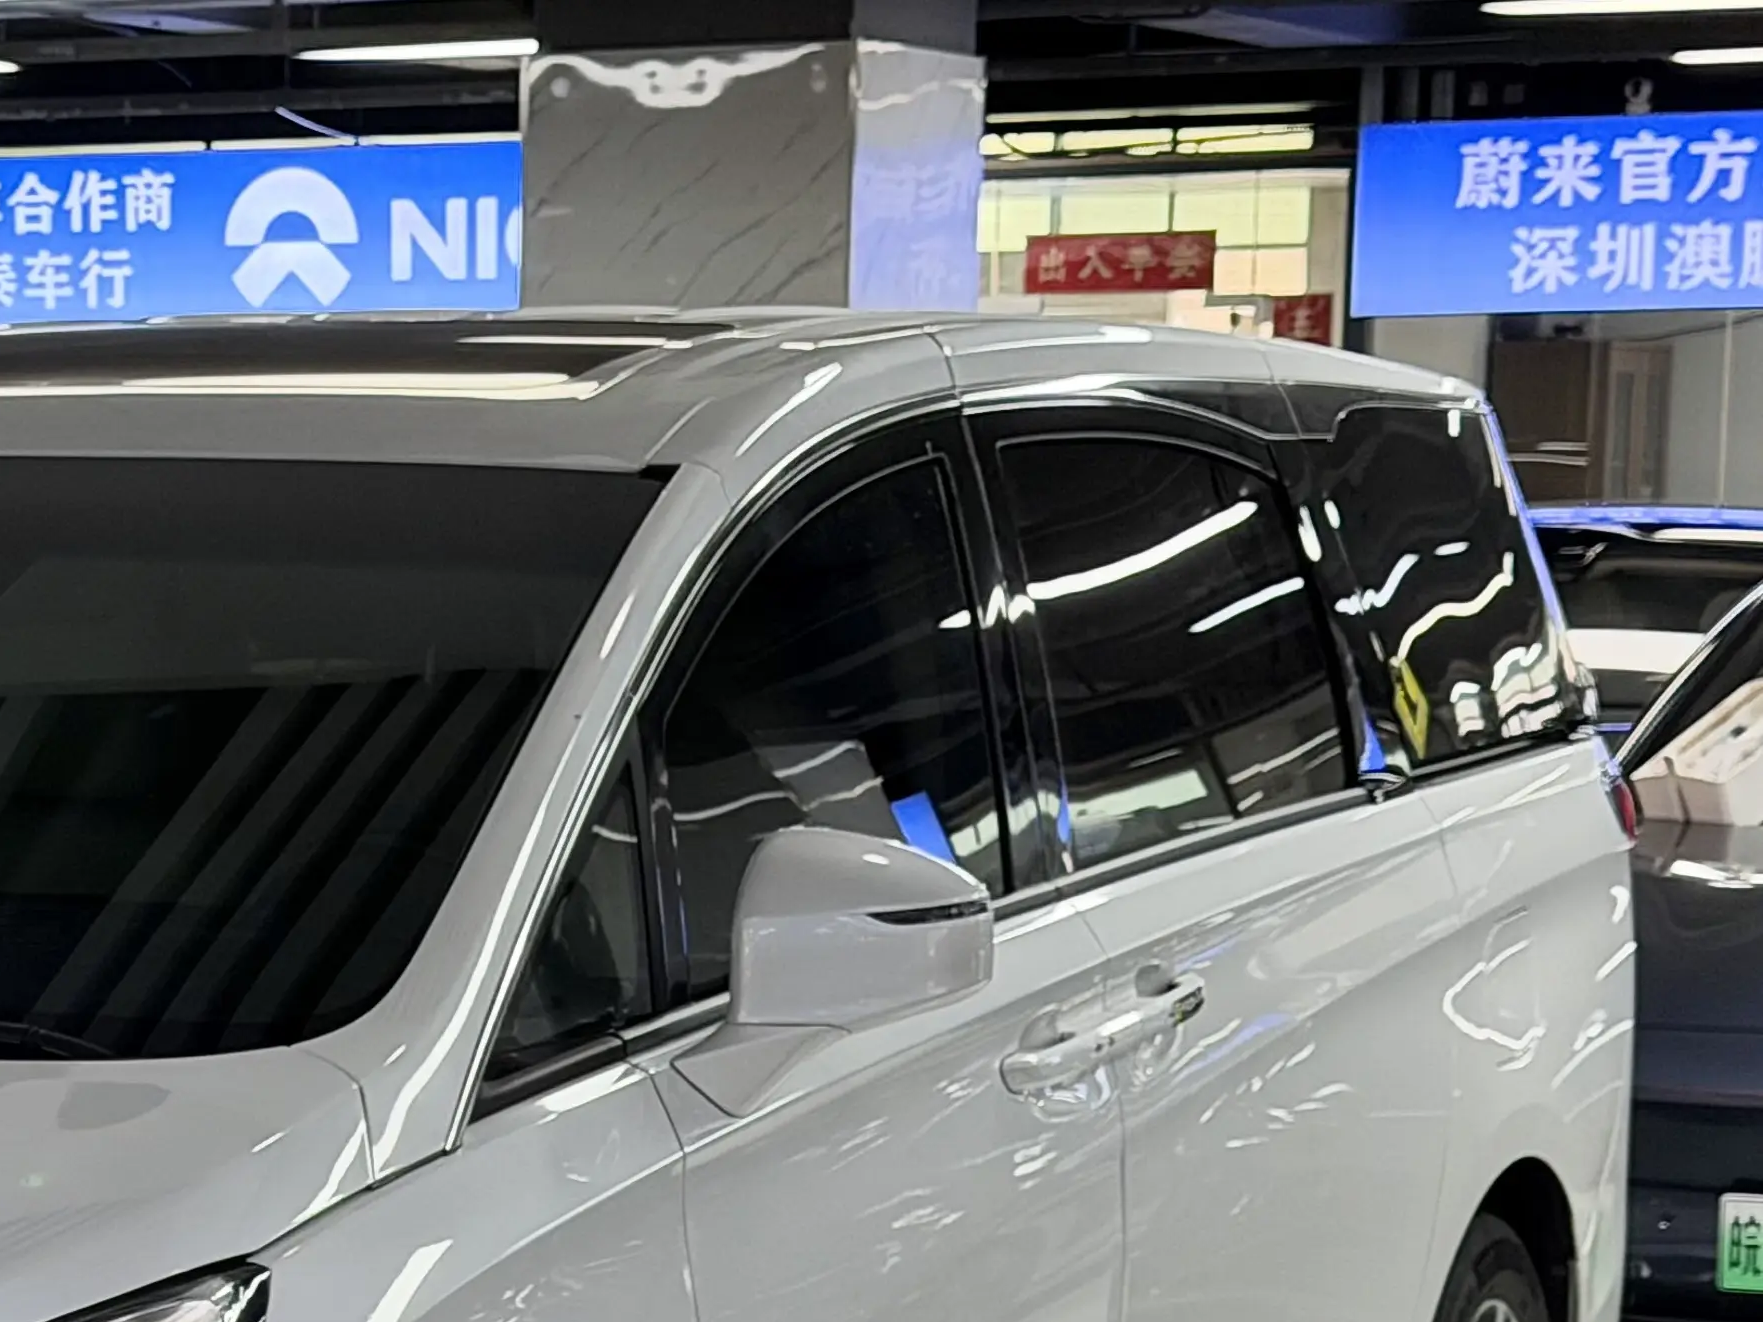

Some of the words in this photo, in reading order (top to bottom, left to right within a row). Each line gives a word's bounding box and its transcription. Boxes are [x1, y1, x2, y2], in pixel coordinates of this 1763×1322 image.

[1454, 127, 1758, 210] 蔚来官方
[390, 196, 523, 282] NI
